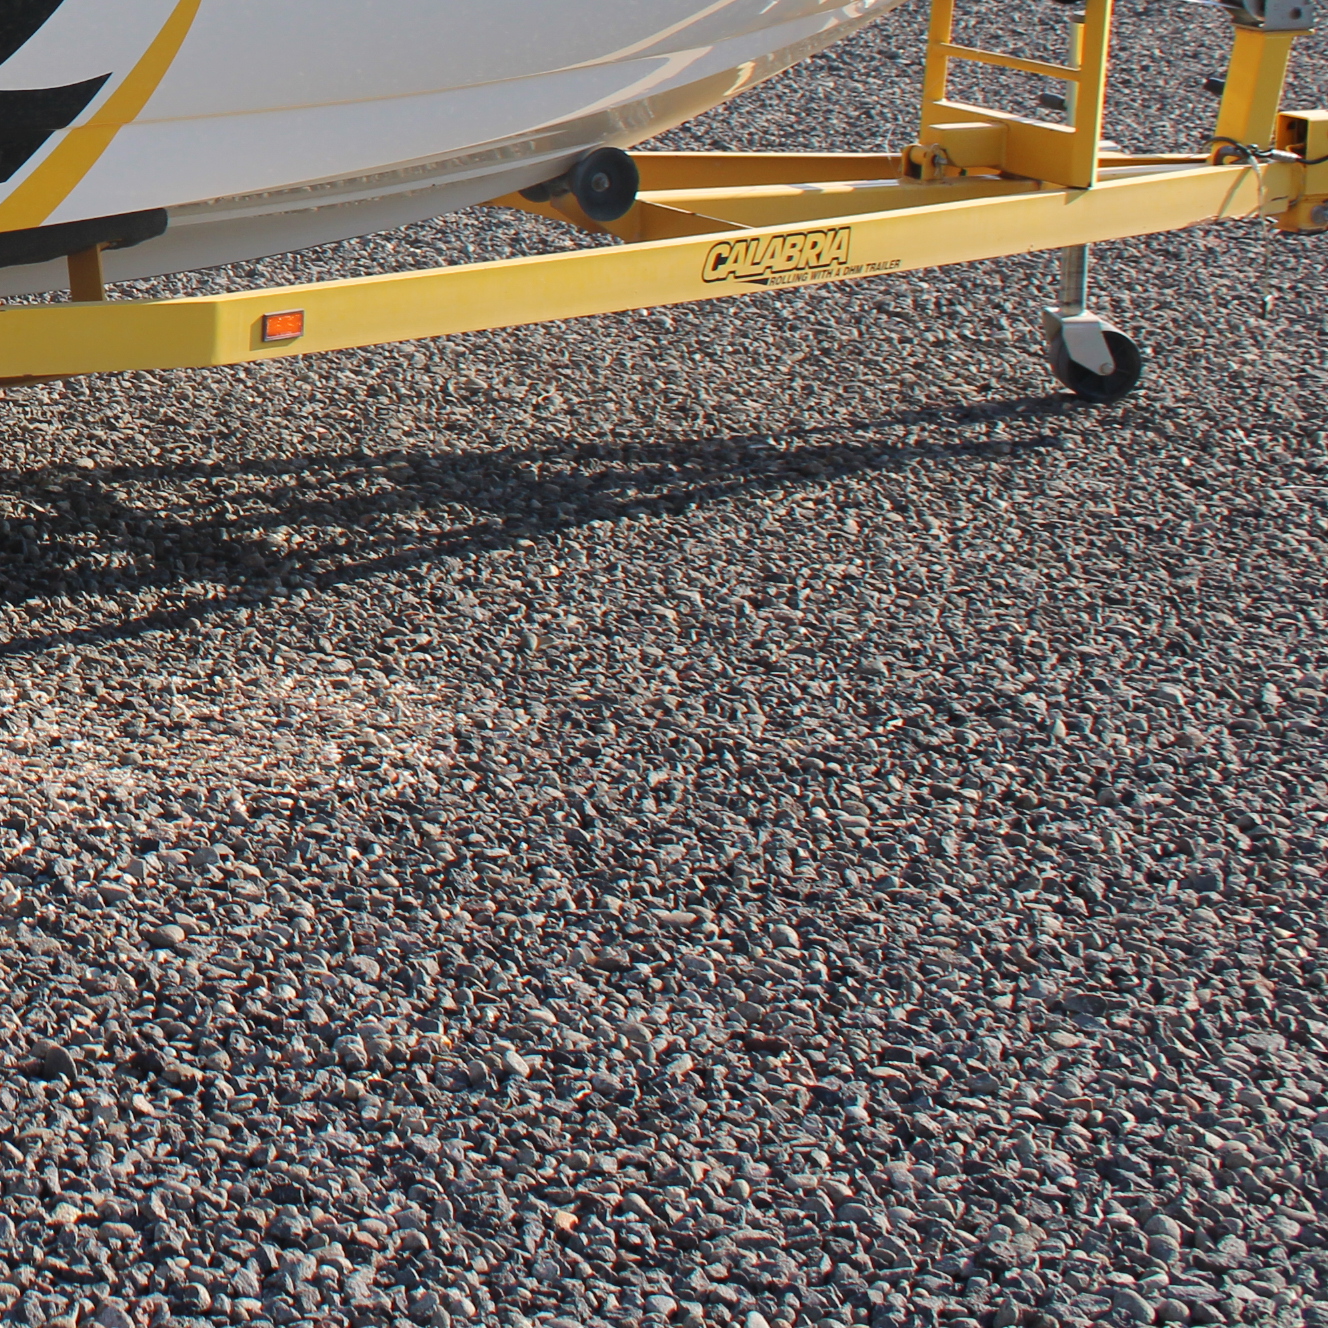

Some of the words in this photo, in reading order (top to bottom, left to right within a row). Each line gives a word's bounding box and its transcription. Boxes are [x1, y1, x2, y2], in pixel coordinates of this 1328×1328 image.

[701, 225, 852, 284] CALABRIA
[768, 273, 808, 286] ROLLING
[810, 269, 833, 281] WITH
[834, 267, 843, 278] A
[842, 264, 864, 276] DHM
[864, 259, 902, 273] TRAILER
